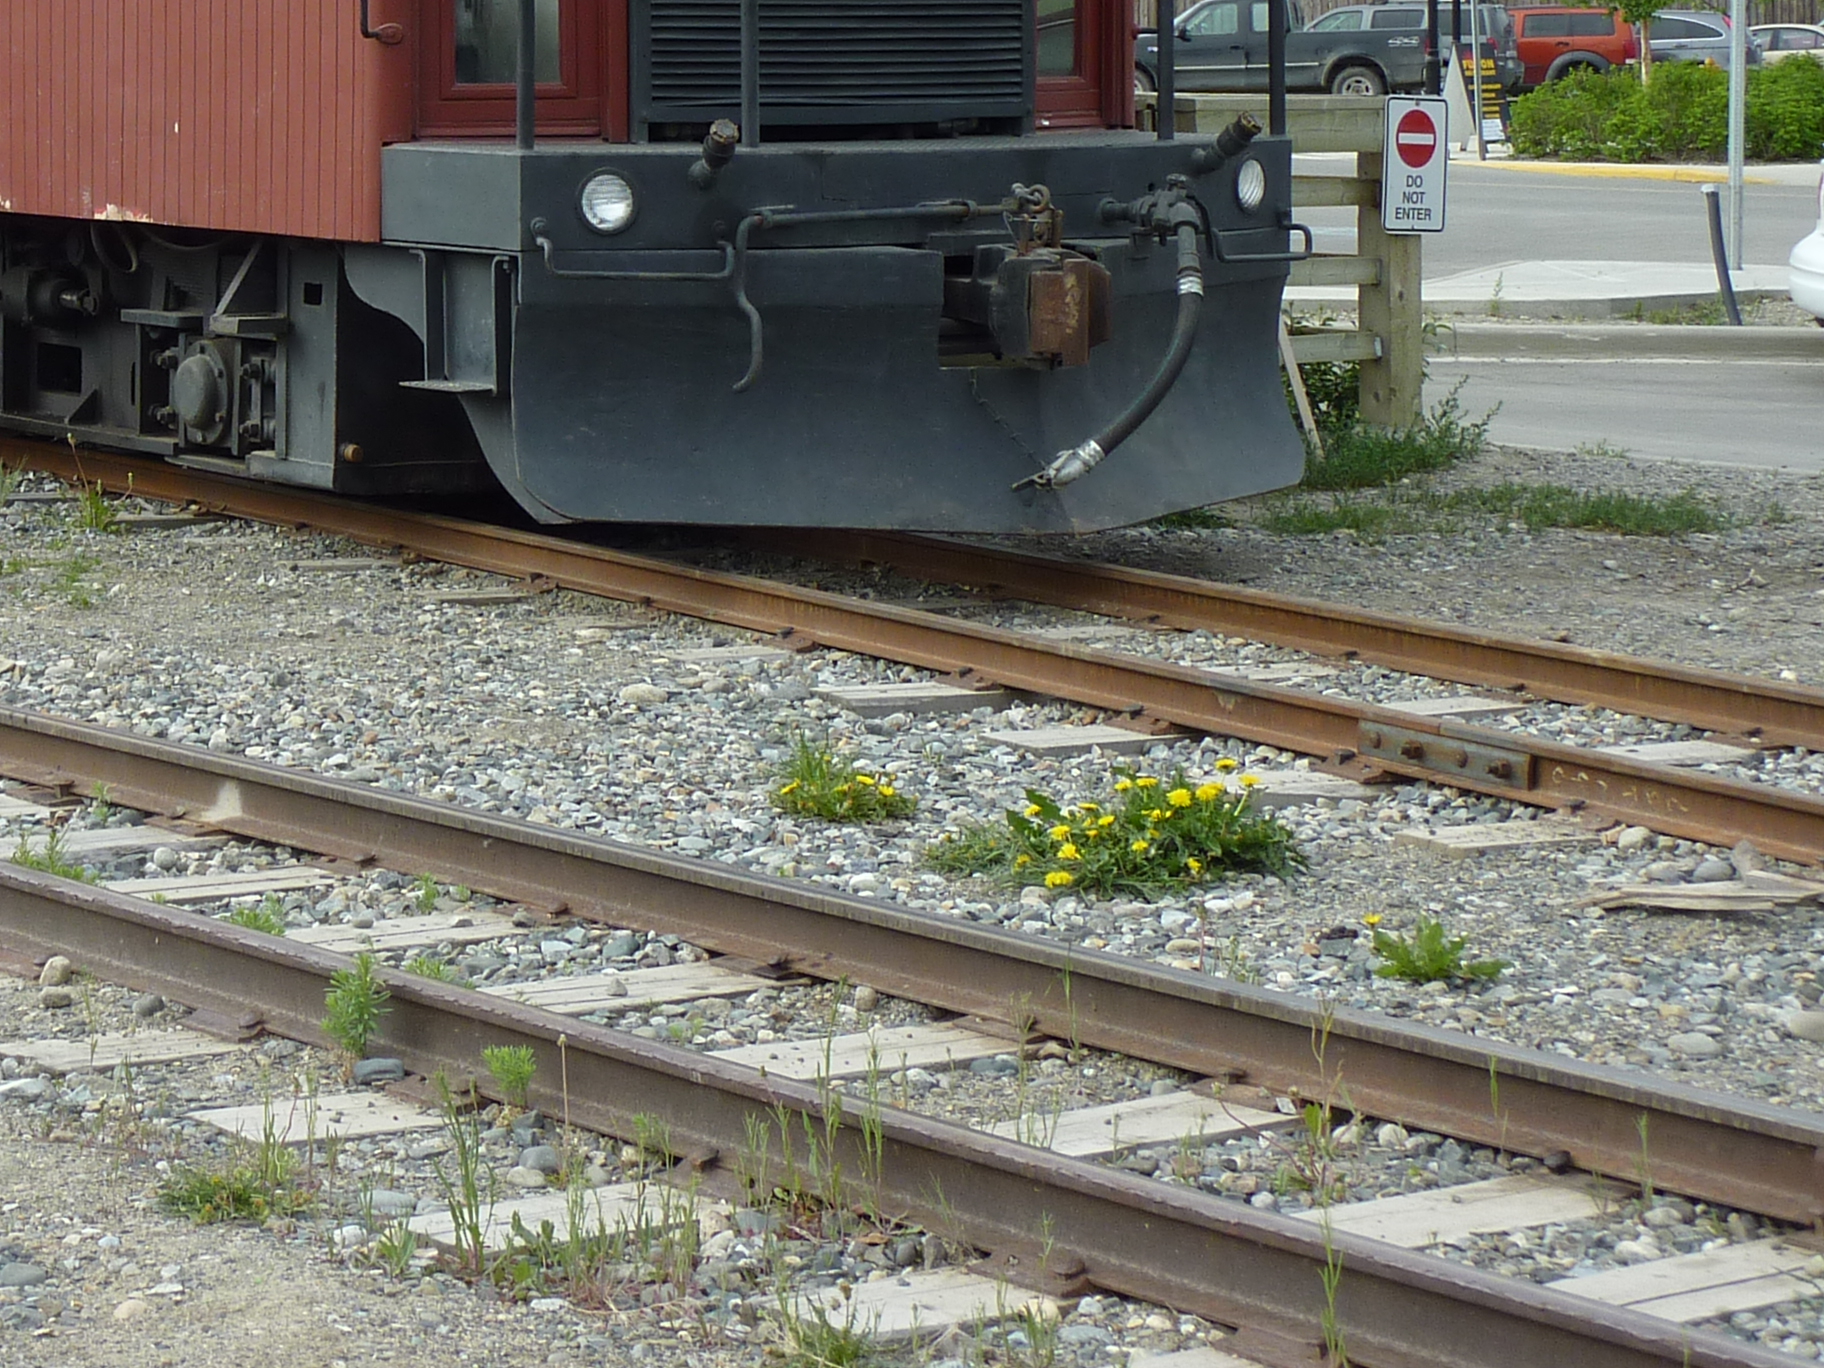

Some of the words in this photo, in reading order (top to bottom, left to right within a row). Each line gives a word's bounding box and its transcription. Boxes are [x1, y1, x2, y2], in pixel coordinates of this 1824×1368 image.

[1462, 58, 1495, 70] YUON
[1406, 175, 1423, 188] DO
[1402, 191, 1426, 204] NOT
[1395, 207, 1432, 221] ENTER
